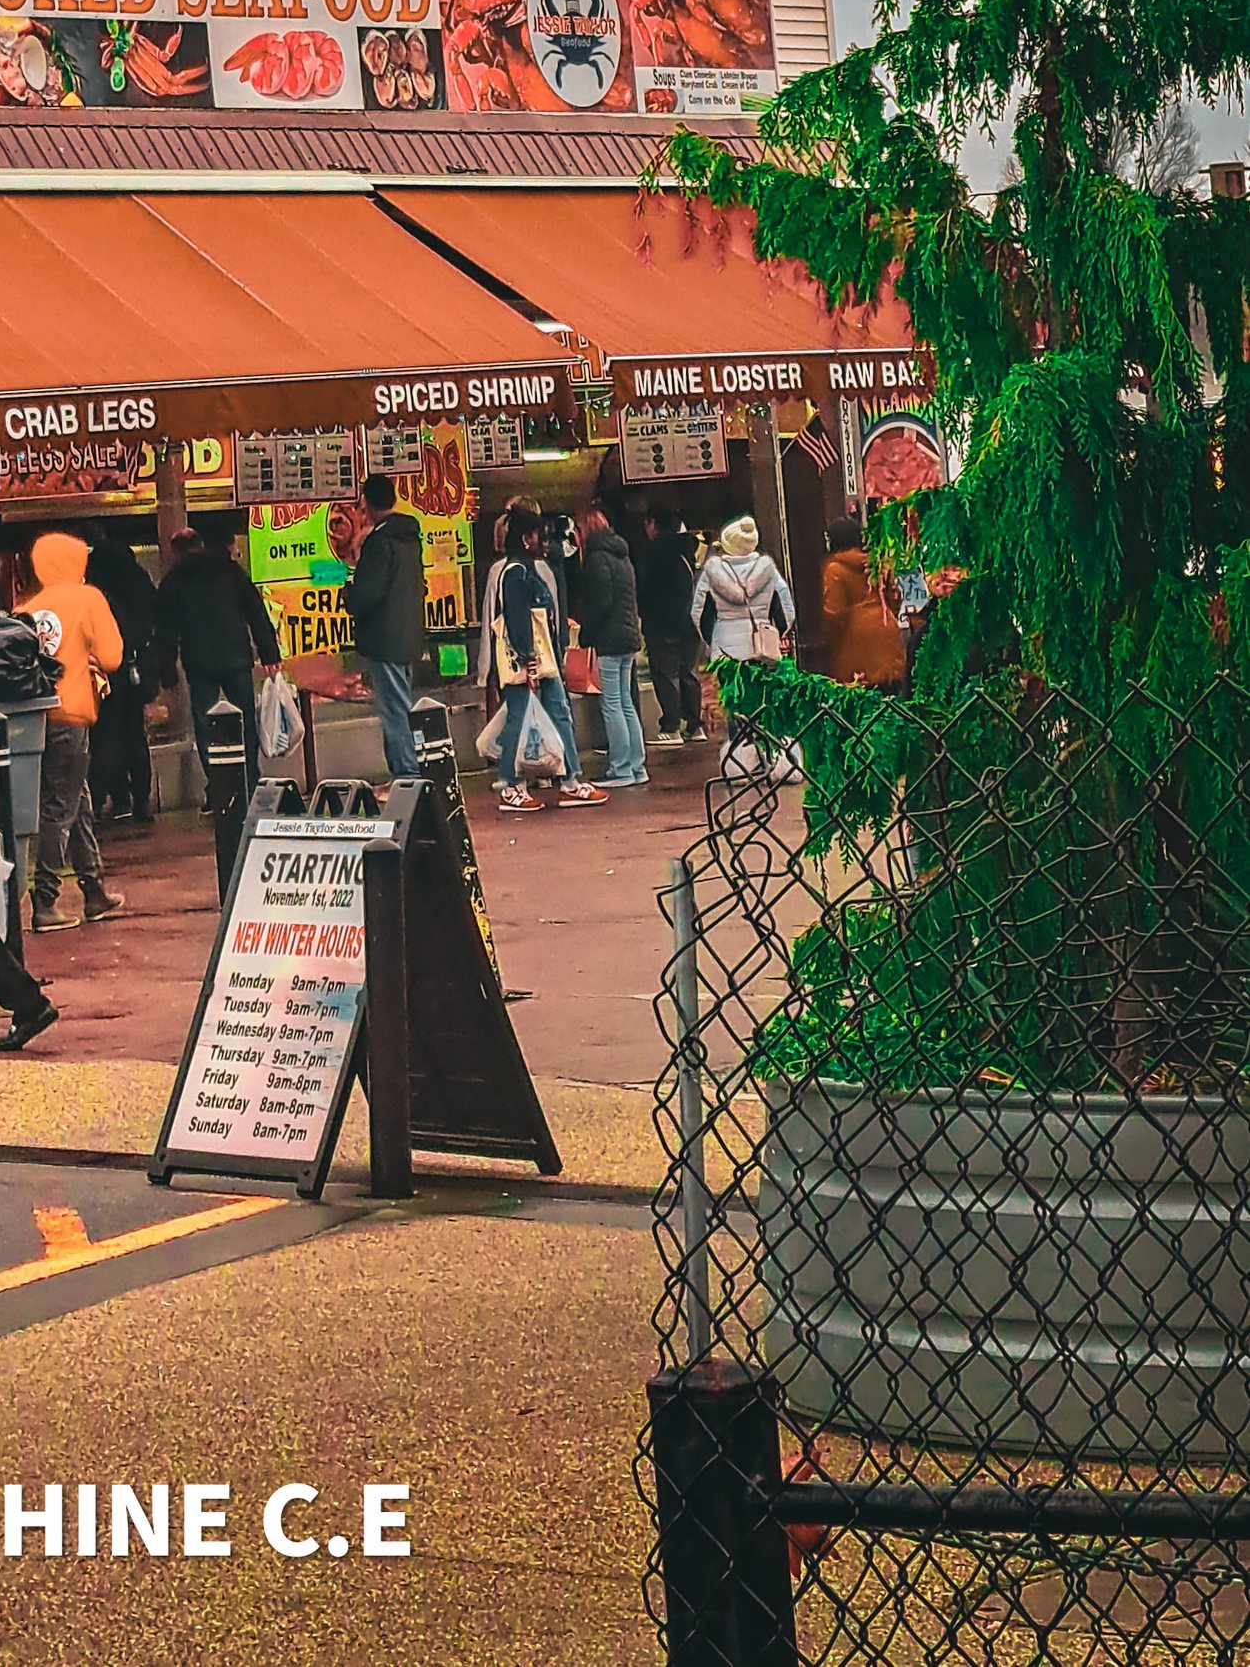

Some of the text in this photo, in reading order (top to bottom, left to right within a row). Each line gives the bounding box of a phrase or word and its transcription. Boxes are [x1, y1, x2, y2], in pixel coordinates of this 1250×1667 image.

[653, 68, 676, 88] Soups
[634, 363, 802, 397] MAINE LOBSTER
[829, 362, 874, 389] RAW
[375, 376, 555, 415] SPICED SHRIMP
[4, 397, 156, 440] CRAB LEGS
[640, 425, 668, 436] CLAMS
[270, 542, 316, 559] ON THE
[272, 822, 376, 834] Jessie Taylor Seafood
[262, 888, 354, 911] November 1st, 2022
[232, 921, 365, 959] NEW WINTER HOURS
[228, 972, 346, 996] Monday 9am-7pm
[223, 996, 340, 1021] Tuesday 9am-7pm
[216, 1019, 334, 1045] Wednesday 9am-7pm
[210, 1044, 327, 1070] Thursday 9am-7pm
[201, 1067, 322, 1095] Friday 9am-8pm
[195, 1091, 315, 1120] Saturday 8am-8pm
[188, 1116, 307, 1144] Sunday 8am-7pm
